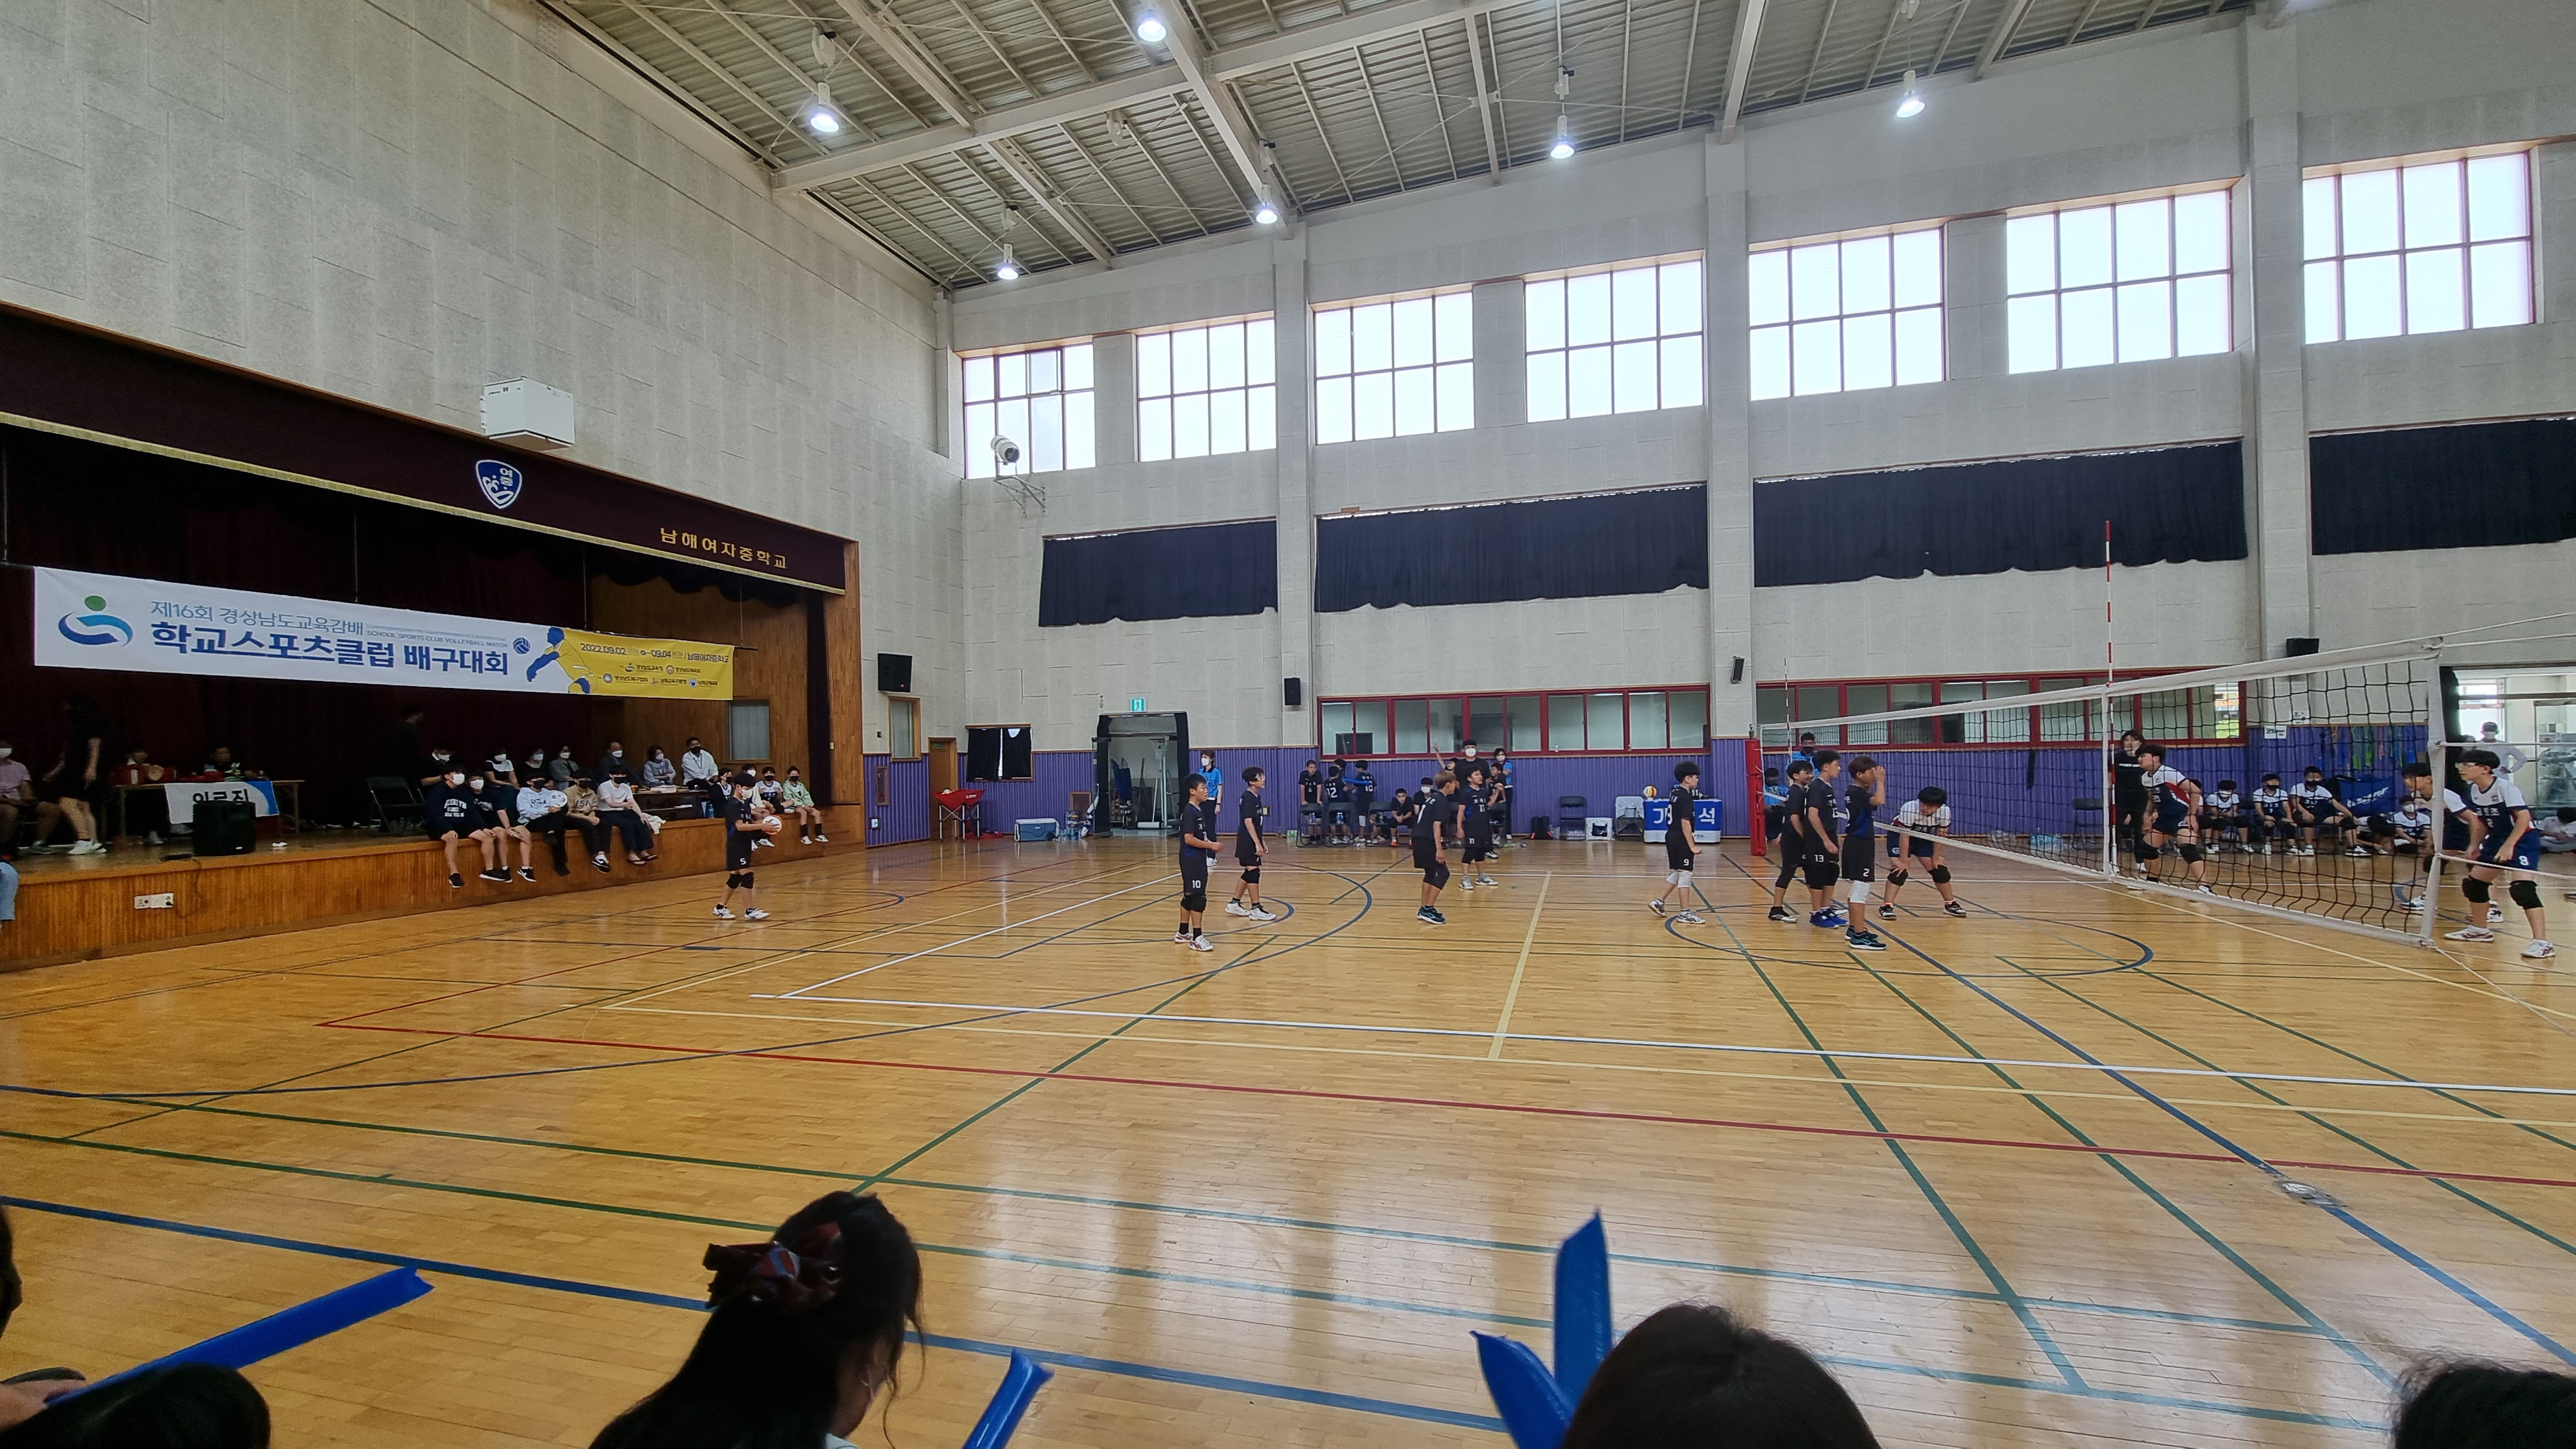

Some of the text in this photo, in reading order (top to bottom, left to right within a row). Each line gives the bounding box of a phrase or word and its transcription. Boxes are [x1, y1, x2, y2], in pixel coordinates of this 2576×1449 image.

[660, 527, 786, 569] 남해여자중학교
[150, 601, 213, 622] 제16회
[219, 608, 364, 636] 경상남도교육감배
[367, 630, 396, 638] SCHOOL
[151, 621, 394, 668] 학교스포츠클럽
[404, 645, 508, 675] 배구대회
[1326, 787, 1338, 799] 12
[1692, 788, 1699, 797] 11
[1814, 854, 1824, 862] 13
[1863, 868, 1870, 877] 2
[1192, 880, 1201, 889] 10
